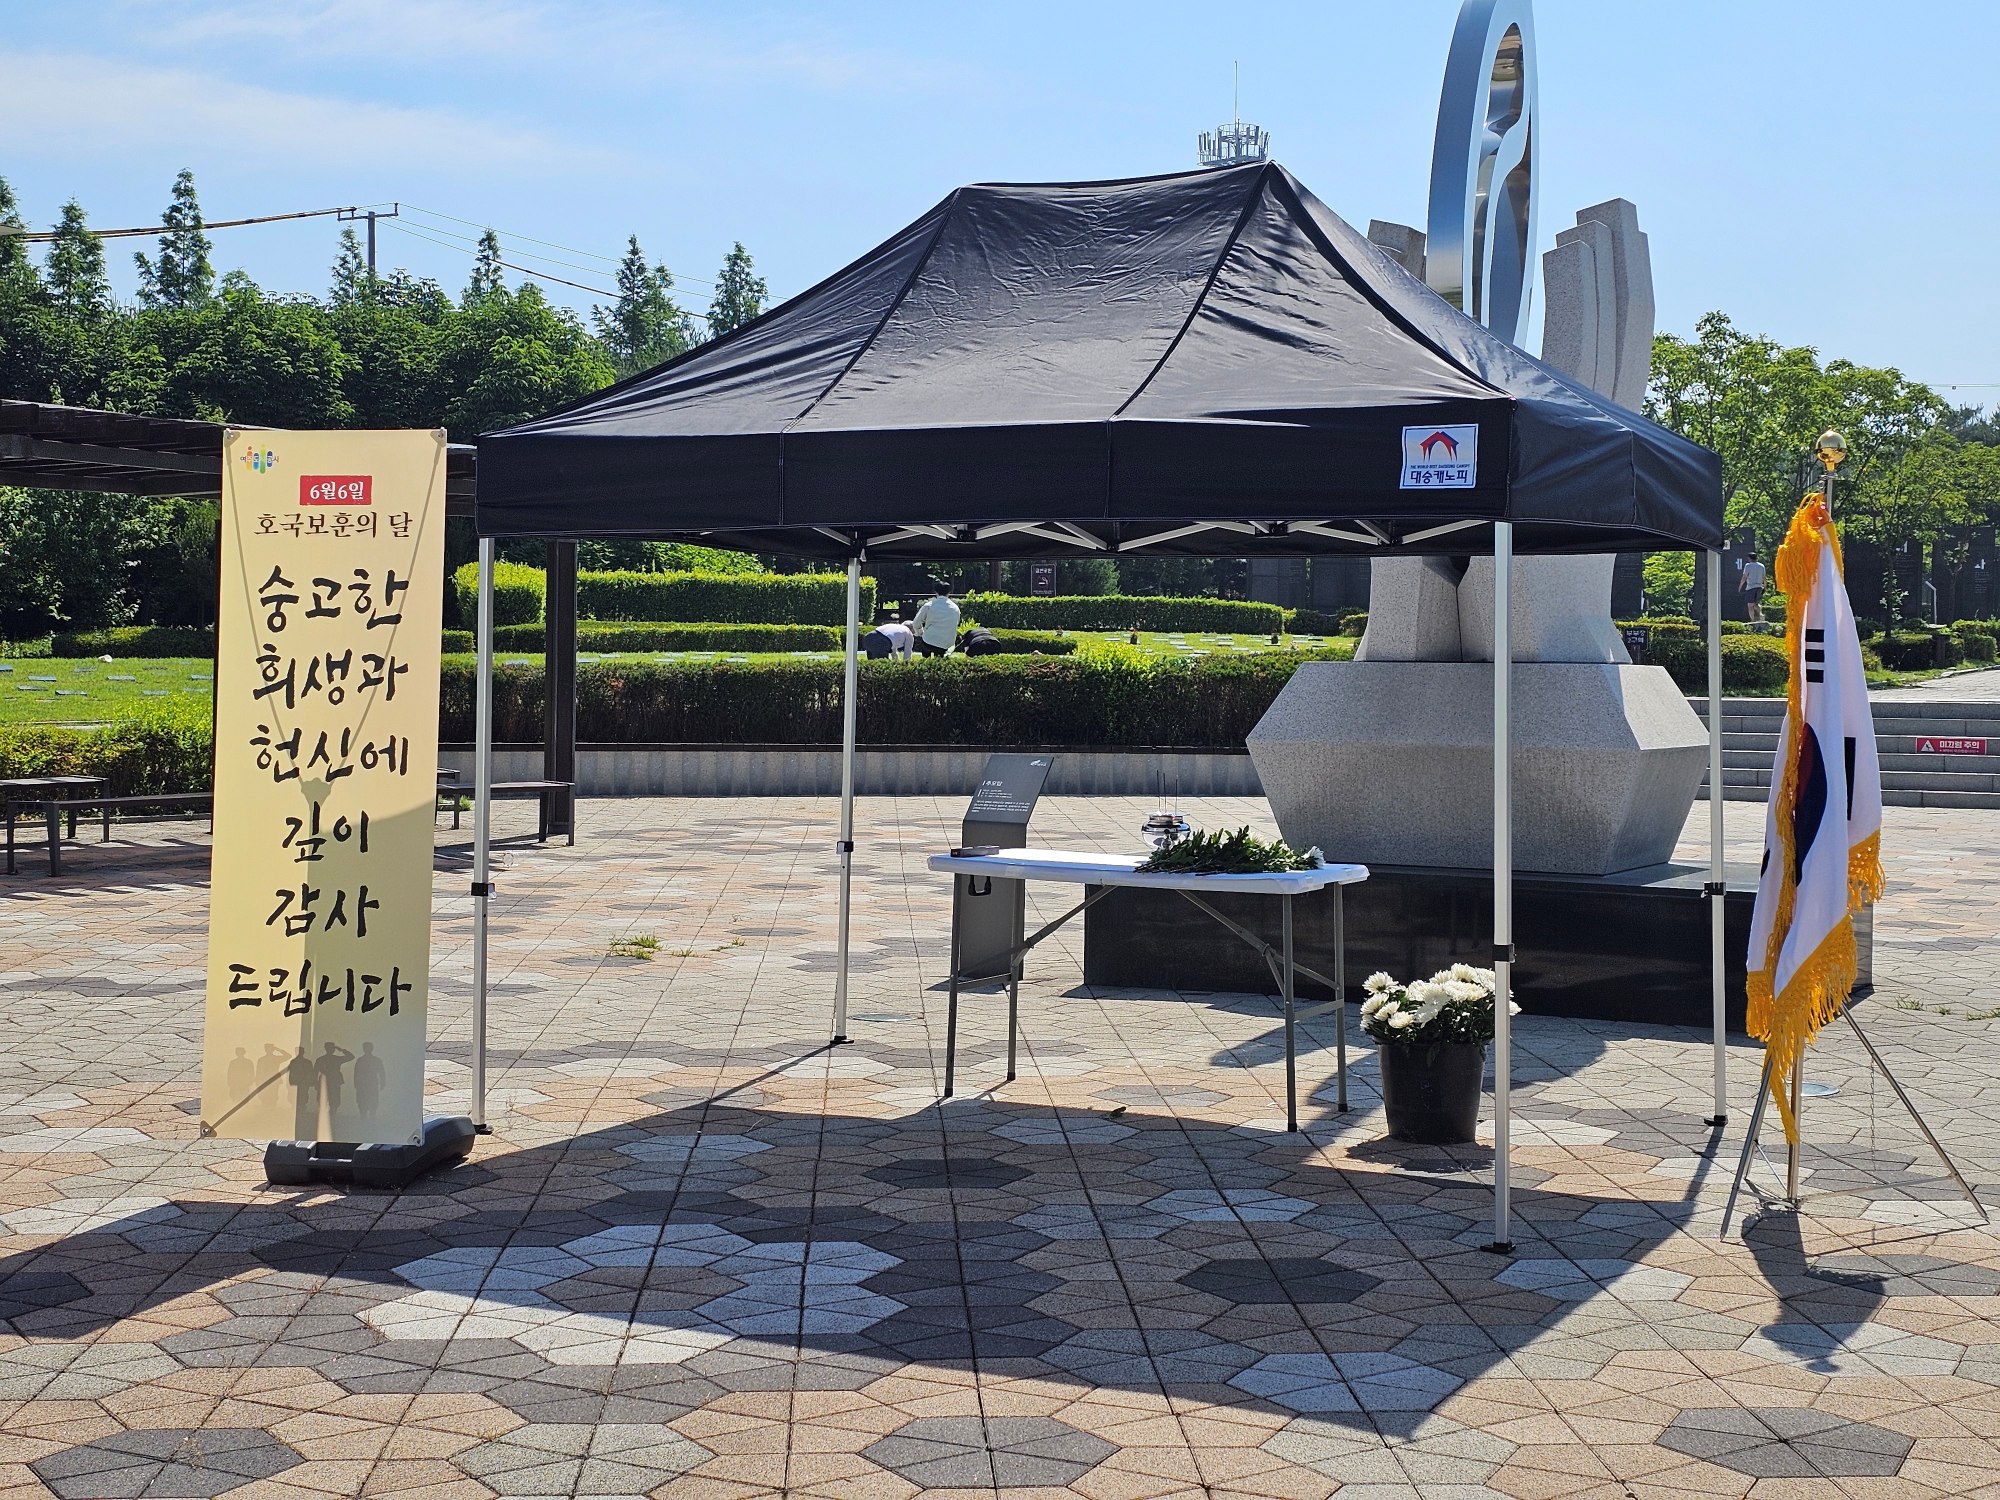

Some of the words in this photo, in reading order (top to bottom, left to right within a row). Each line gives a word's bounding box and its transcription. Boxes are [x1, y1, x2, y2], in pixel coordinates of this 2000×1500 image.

[310, 481, 364, 500] 6월6일
[1410, 470, 1468, 484] 대승캐노피
[253, 511, 377, 538] 호국보훈의
[388, 511, 413, 538] 달
[258, 565, 409, 633] 숭고한
[252, 643, 409, 709] 희생과
[250, 725, 408, 783] 헌신에
[1940, 740, 1962, 748] 미끄럼
[1964, 740, 1979, 749] 주의
[282, 801, 369, 863] 깊이
[266, 883, 380, 938] 감사
[228, 959, 412, 1018] 드립니다
